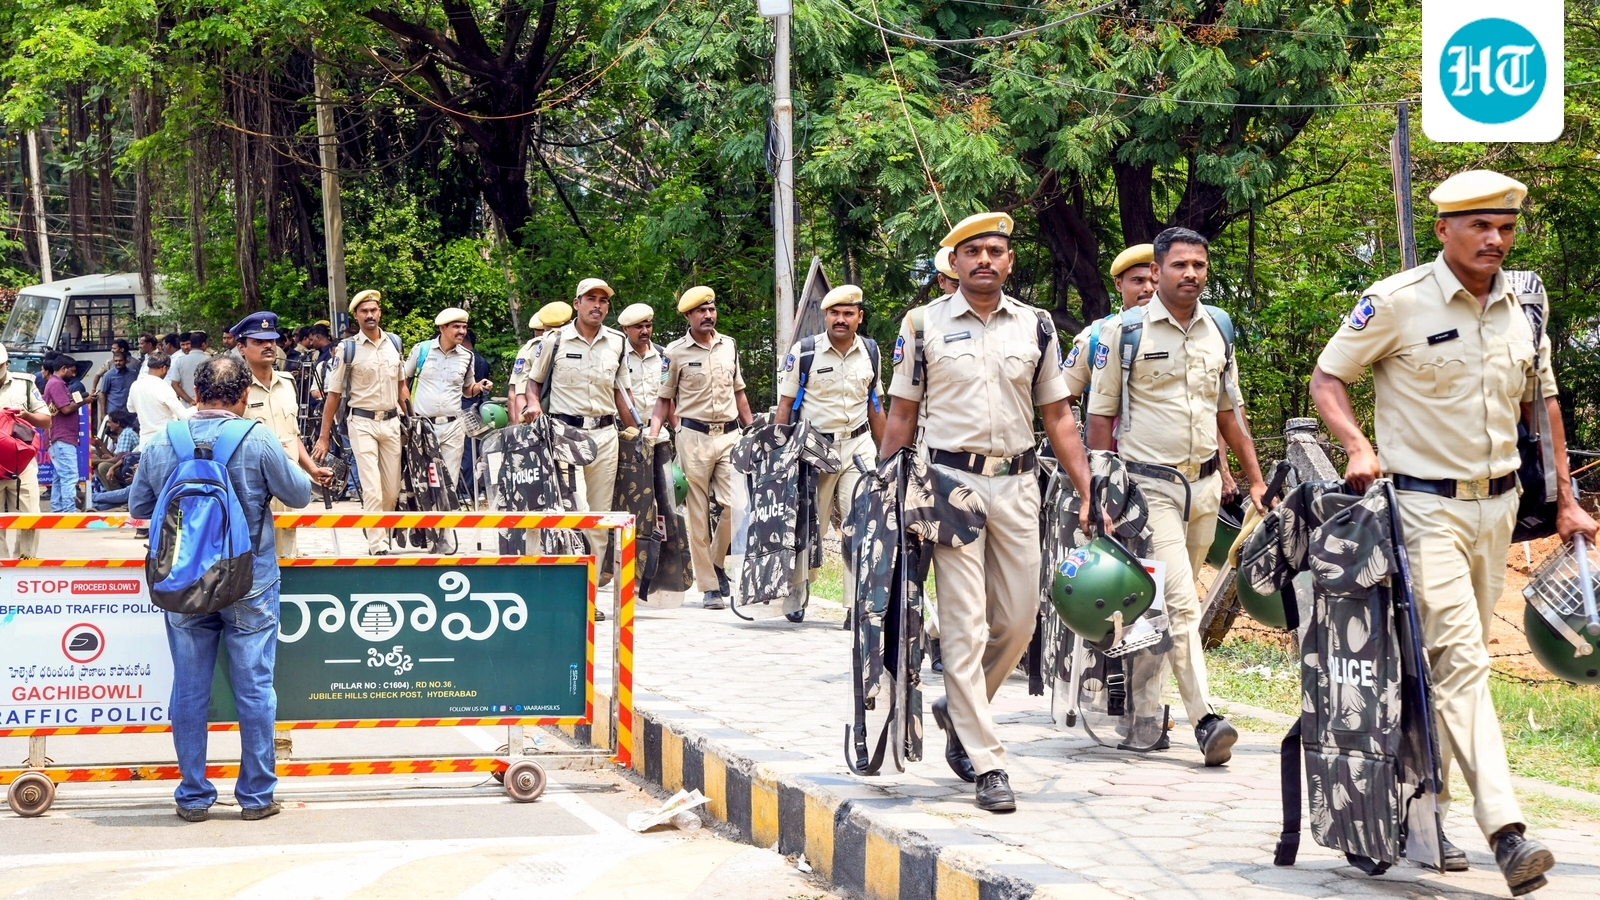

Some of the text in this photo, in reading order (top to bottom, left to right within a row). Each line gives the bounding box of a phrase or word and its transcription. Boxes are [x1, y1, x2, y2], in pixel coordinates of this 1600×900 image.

[512, 467, 540, 486] POLICE
[756, 502, 784, 522] POLICE
[16, 580, 69, 594] STOP
[73, 583, 138, 591] PROCEED SLOWLY
[0, 604, 62, 615] BERABAD
[66, 604, 119, 614] TRAFFIC
[1328, 655, 1374, 687] OLICE
[11, 684, 143, 701] GACHIBOWLI
[330, 681, 363, 690] (PILLAR
[364, 681, 377, 689] NO
[382, 681, 410, 690] C1604)
[428, 680, 452, 688] NO.36
[308, 692, 343, 700] JUBILEE
[369, 691, 399, 699] CHECK
[400, 691, 424, 699] POST,
[426, 690, 478, 698] HYDERABAD
[0, 706, 171, 724] AFFIC POLIC
